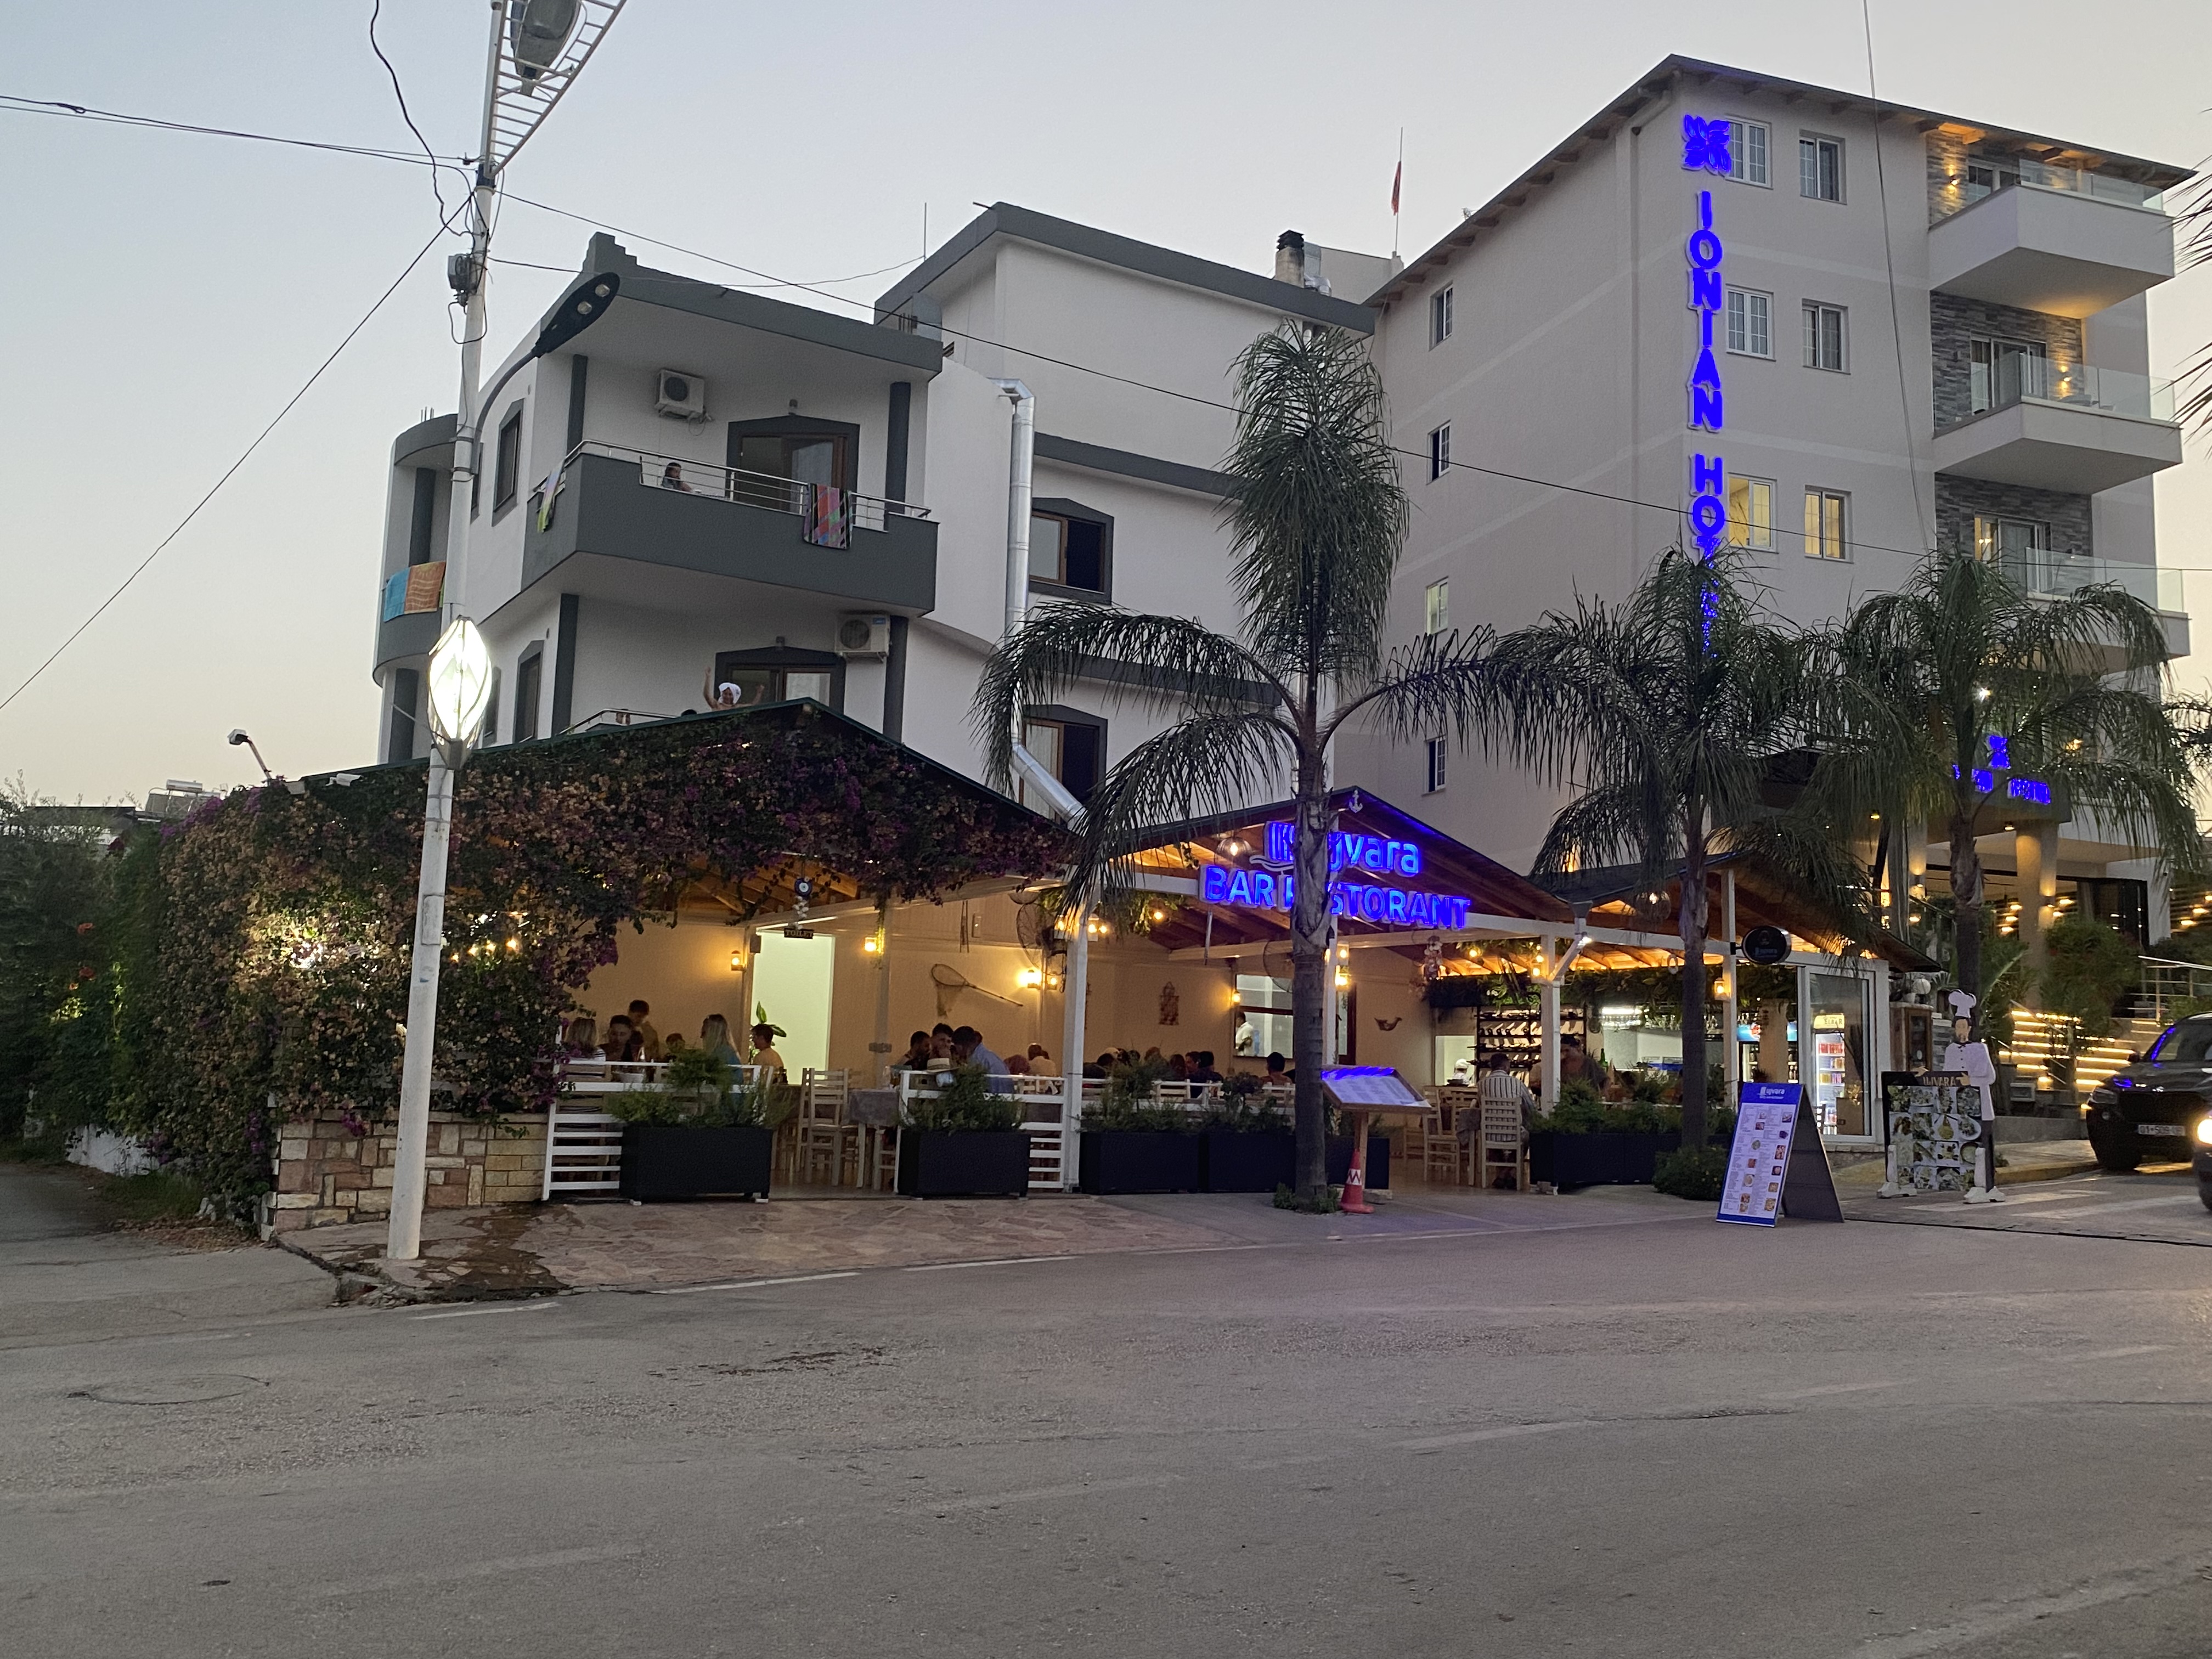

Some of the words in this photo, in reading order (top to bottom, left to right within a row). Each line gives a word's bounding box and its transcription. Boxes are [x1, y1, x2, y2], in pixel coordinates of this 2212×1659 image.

[1689, 190, 1723, 430] IONIAN
[1201, 865, 1276, 909] BAR
[1283, 875, 1470, 929] STORANT
